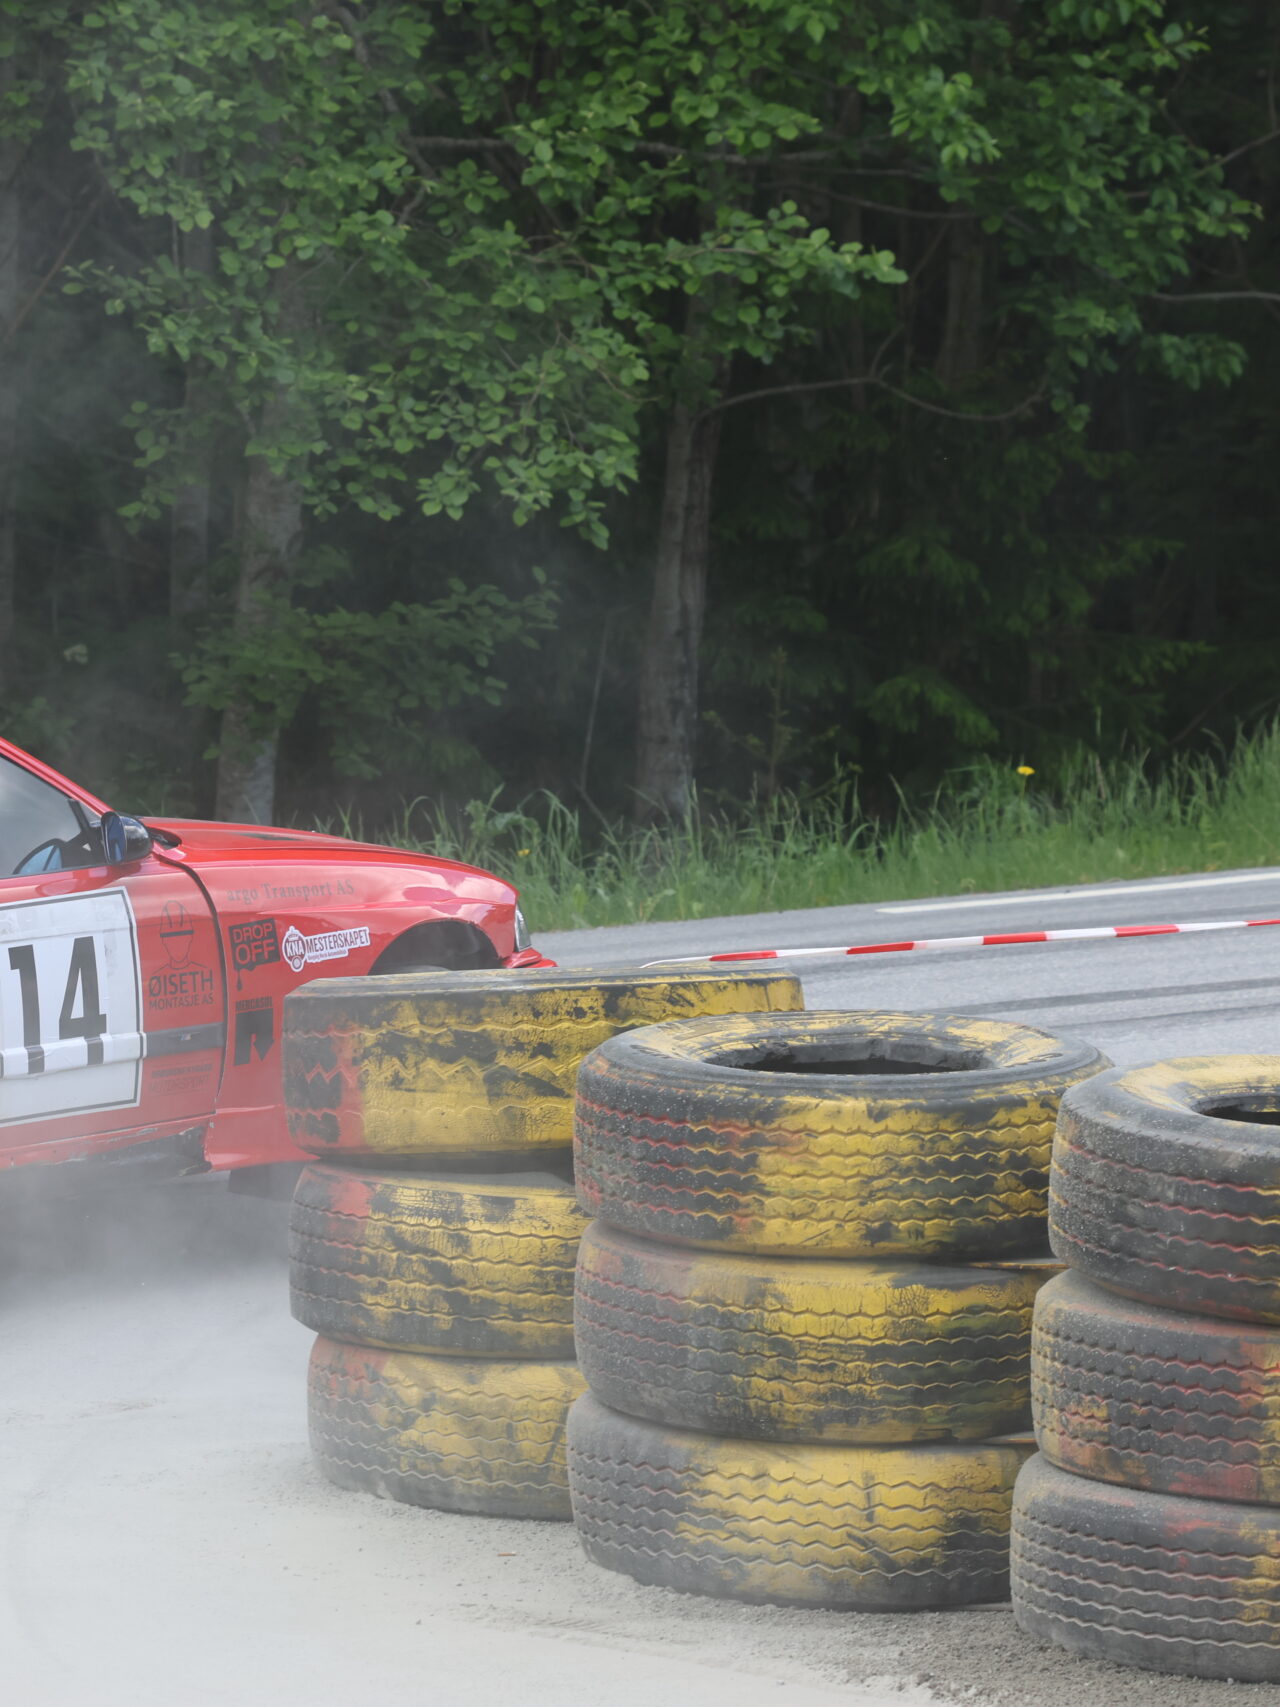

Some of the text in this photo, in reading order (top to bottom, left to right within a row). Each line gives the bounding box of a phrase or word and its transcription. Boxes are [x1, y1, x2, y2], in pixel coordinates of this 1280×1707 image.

[260, 880, 333, 902] Transport
[336, 877, 355, 896] AS
[232, 922, 273, 944] DROP
[285, 929, 370, 957] KNA MESTERSKAPET
[235, 939, 276, 965] OFF
[148, 967, 214, 998] ØISETH
[7, 935, 108, 1075] 14
[148, 991, 215, 1010] MONTASJE AS
